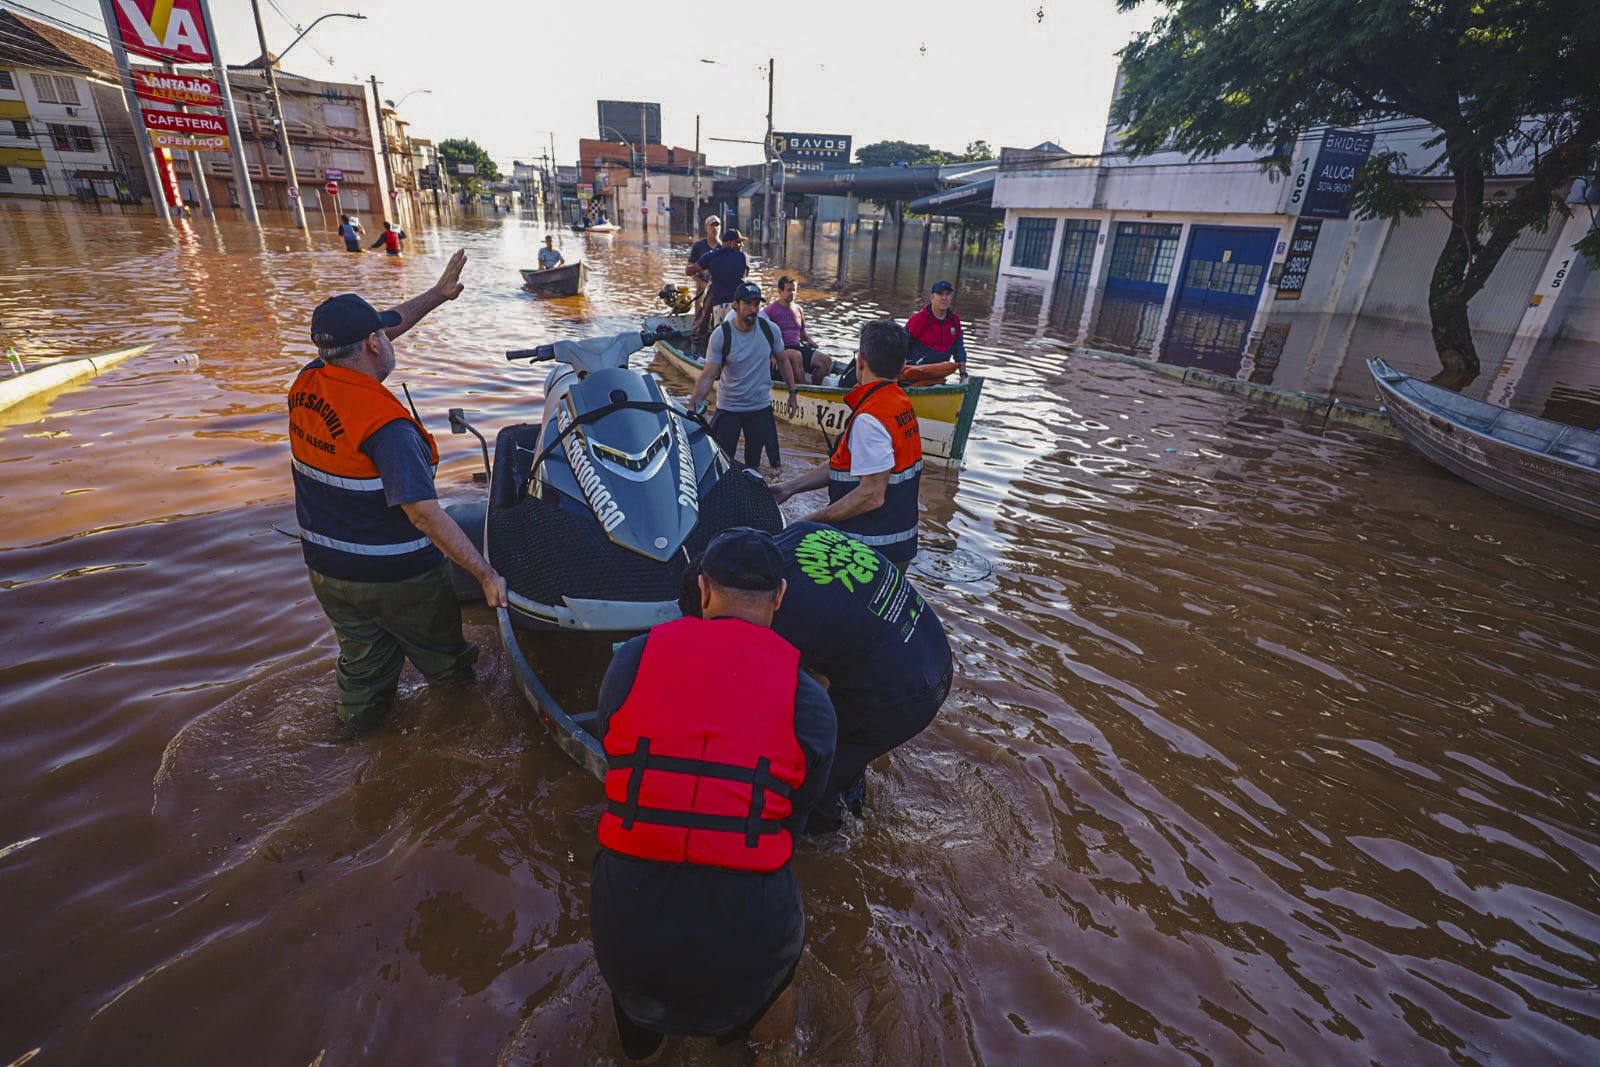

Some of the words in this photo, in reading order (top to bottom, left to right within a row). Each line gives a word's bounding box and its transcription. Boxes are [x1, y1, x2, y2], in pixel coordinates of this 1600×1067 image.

[118, 0, 208, 55] VA
[141, 73, 211, 94] VANTAJÃO
[152, 88, 208, 102] ATACADO
[147, 113, 223, 130] CAFETERIA
[156, 135, 225, 148] OFERTAÇO
[790, 138, 847, 149] GAVOS
[1325, 134, 1370, 152] BRIDGE
[1291, 157, 1310, 204] 165
[1321, 164, 1355, 180] ALUGA
[1293, 239, 1312, 252] ALUGA
[1551, 259, 1570, 288] 165
[306, 433, 336, 455] ALEGRE
[830, 543, 853, 567] THE
[834, 539, 881, 593] TEAM
